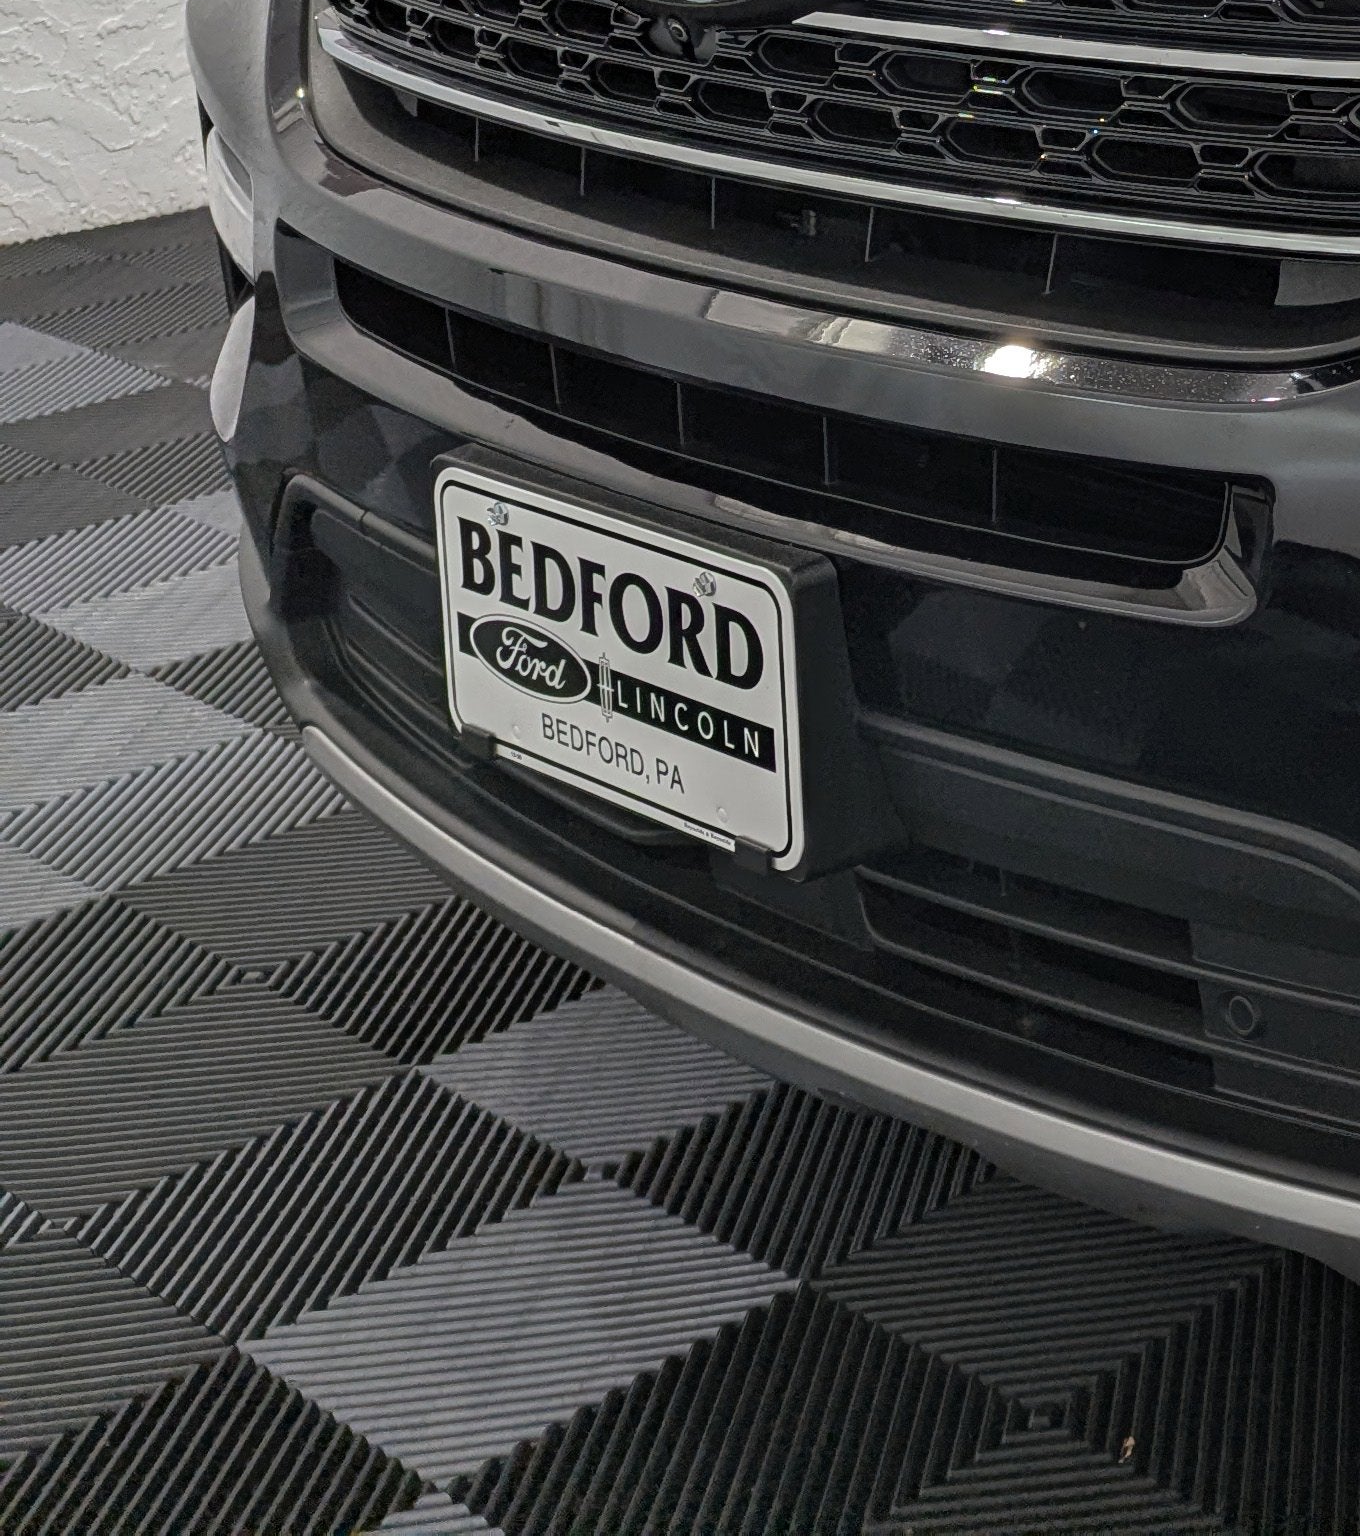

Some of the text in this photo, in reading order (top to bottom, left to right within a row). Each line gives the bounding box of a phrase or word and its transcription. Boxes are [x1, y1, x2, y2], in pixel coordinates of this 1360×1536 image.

[457, 516, 764, 691] BEDFORD
[495, 626, 760, 759] Ford LINCOLN
[540, 712, 685, 794] BEDFORD, PA
